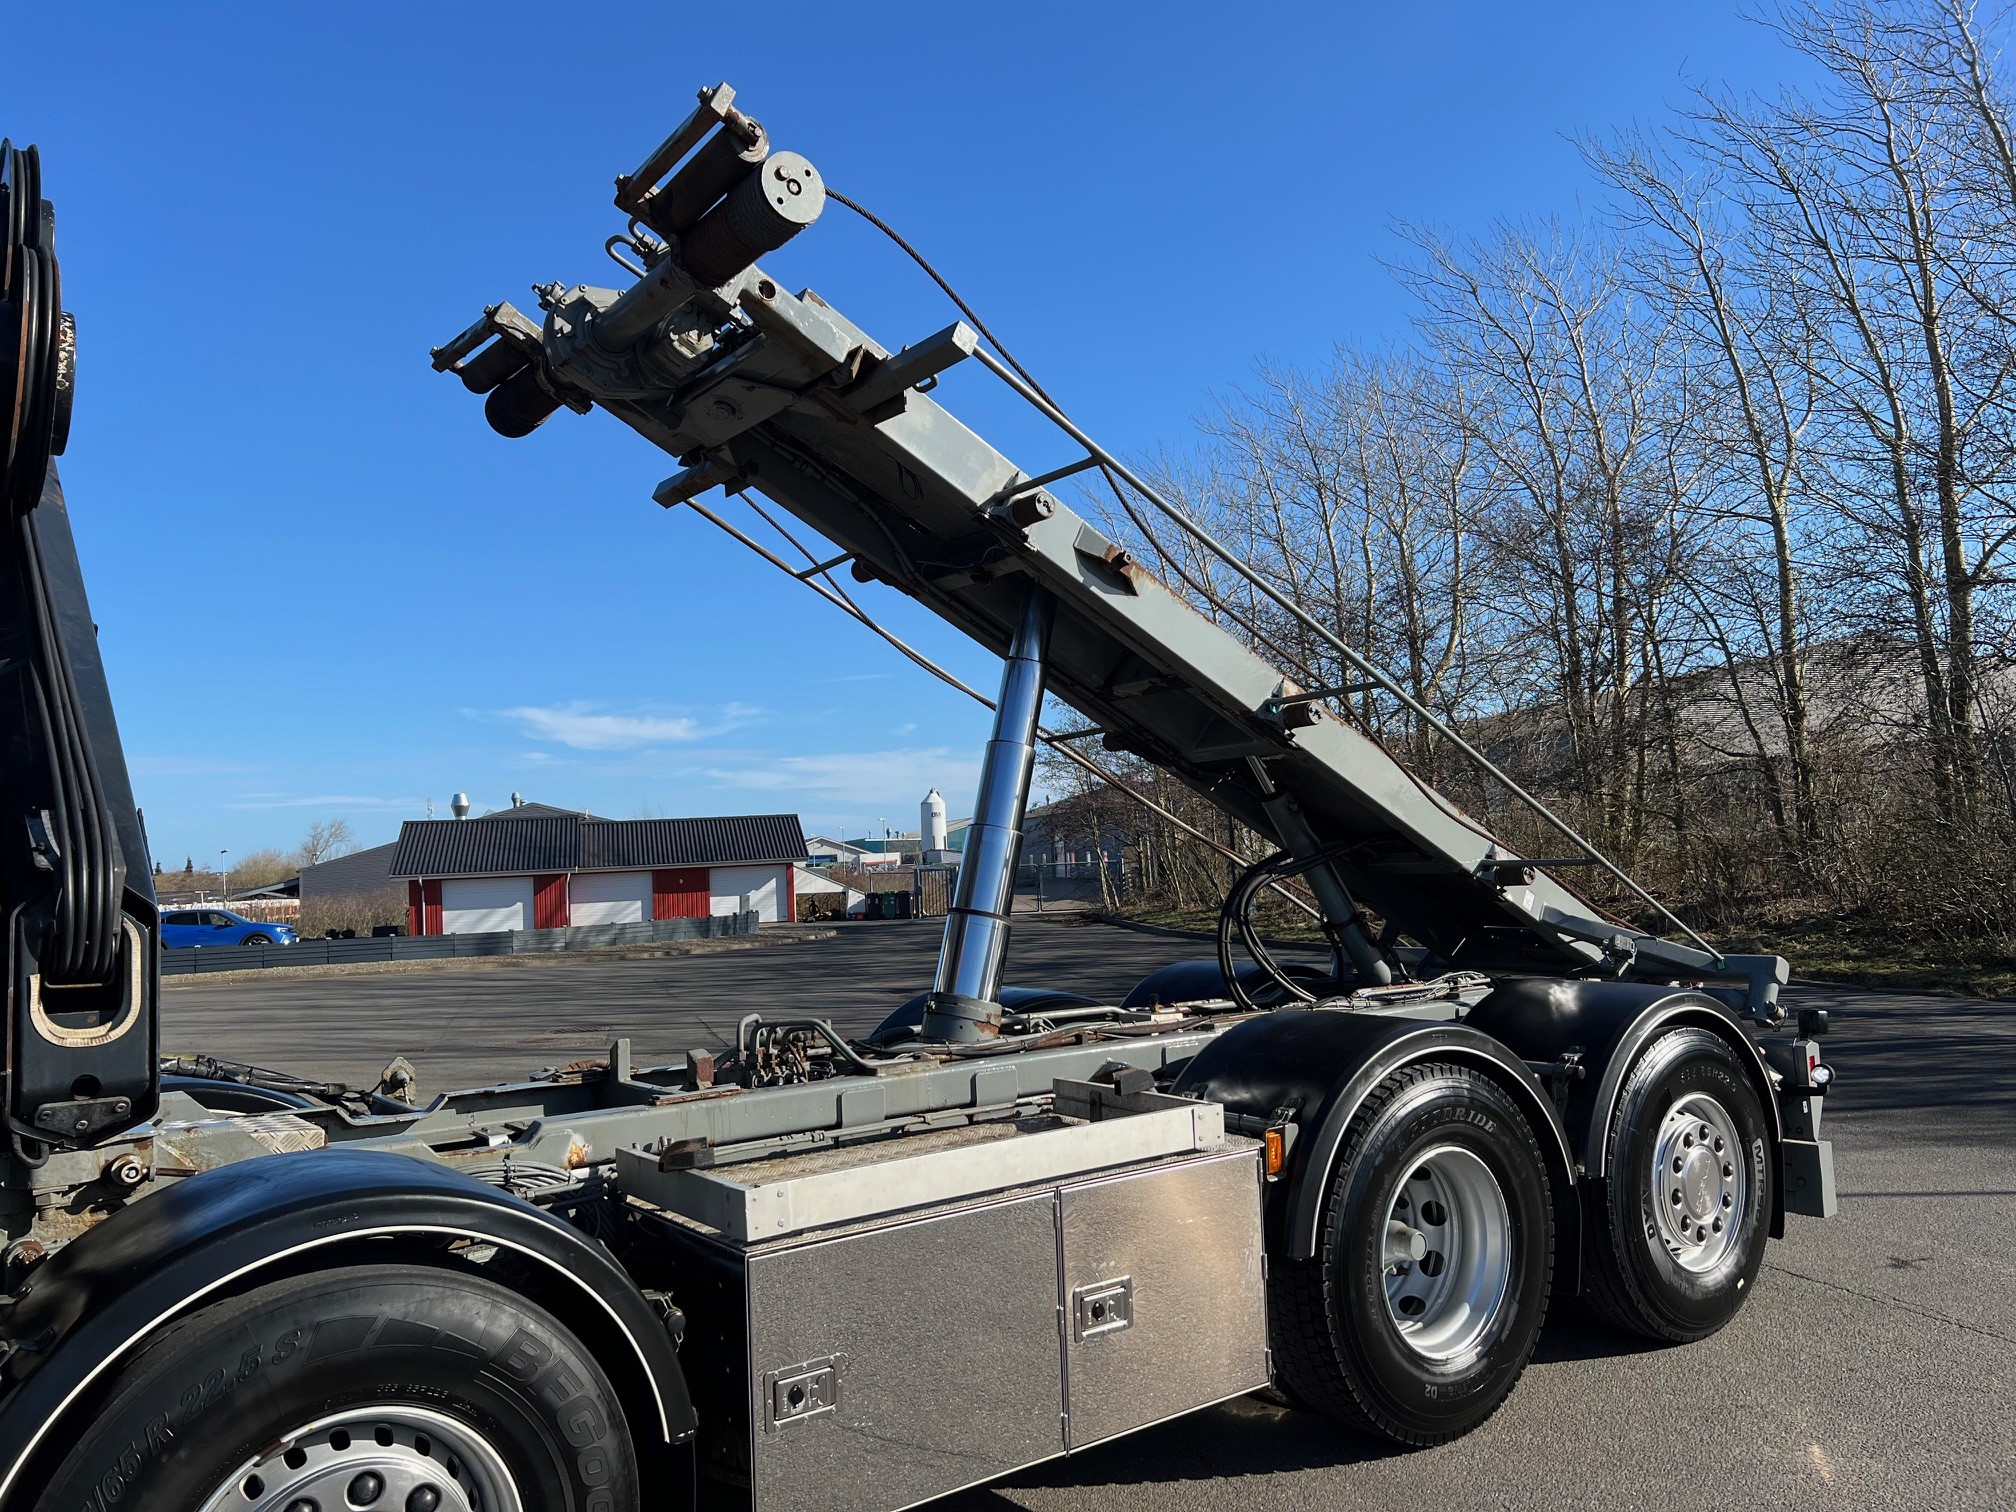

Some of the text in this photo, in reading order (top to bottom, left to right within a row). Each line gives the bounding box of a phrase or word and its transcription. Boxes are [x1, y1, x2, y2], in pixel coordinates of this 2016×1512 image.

[80, 1329, 303, 1512] /65 R 22.5 S
